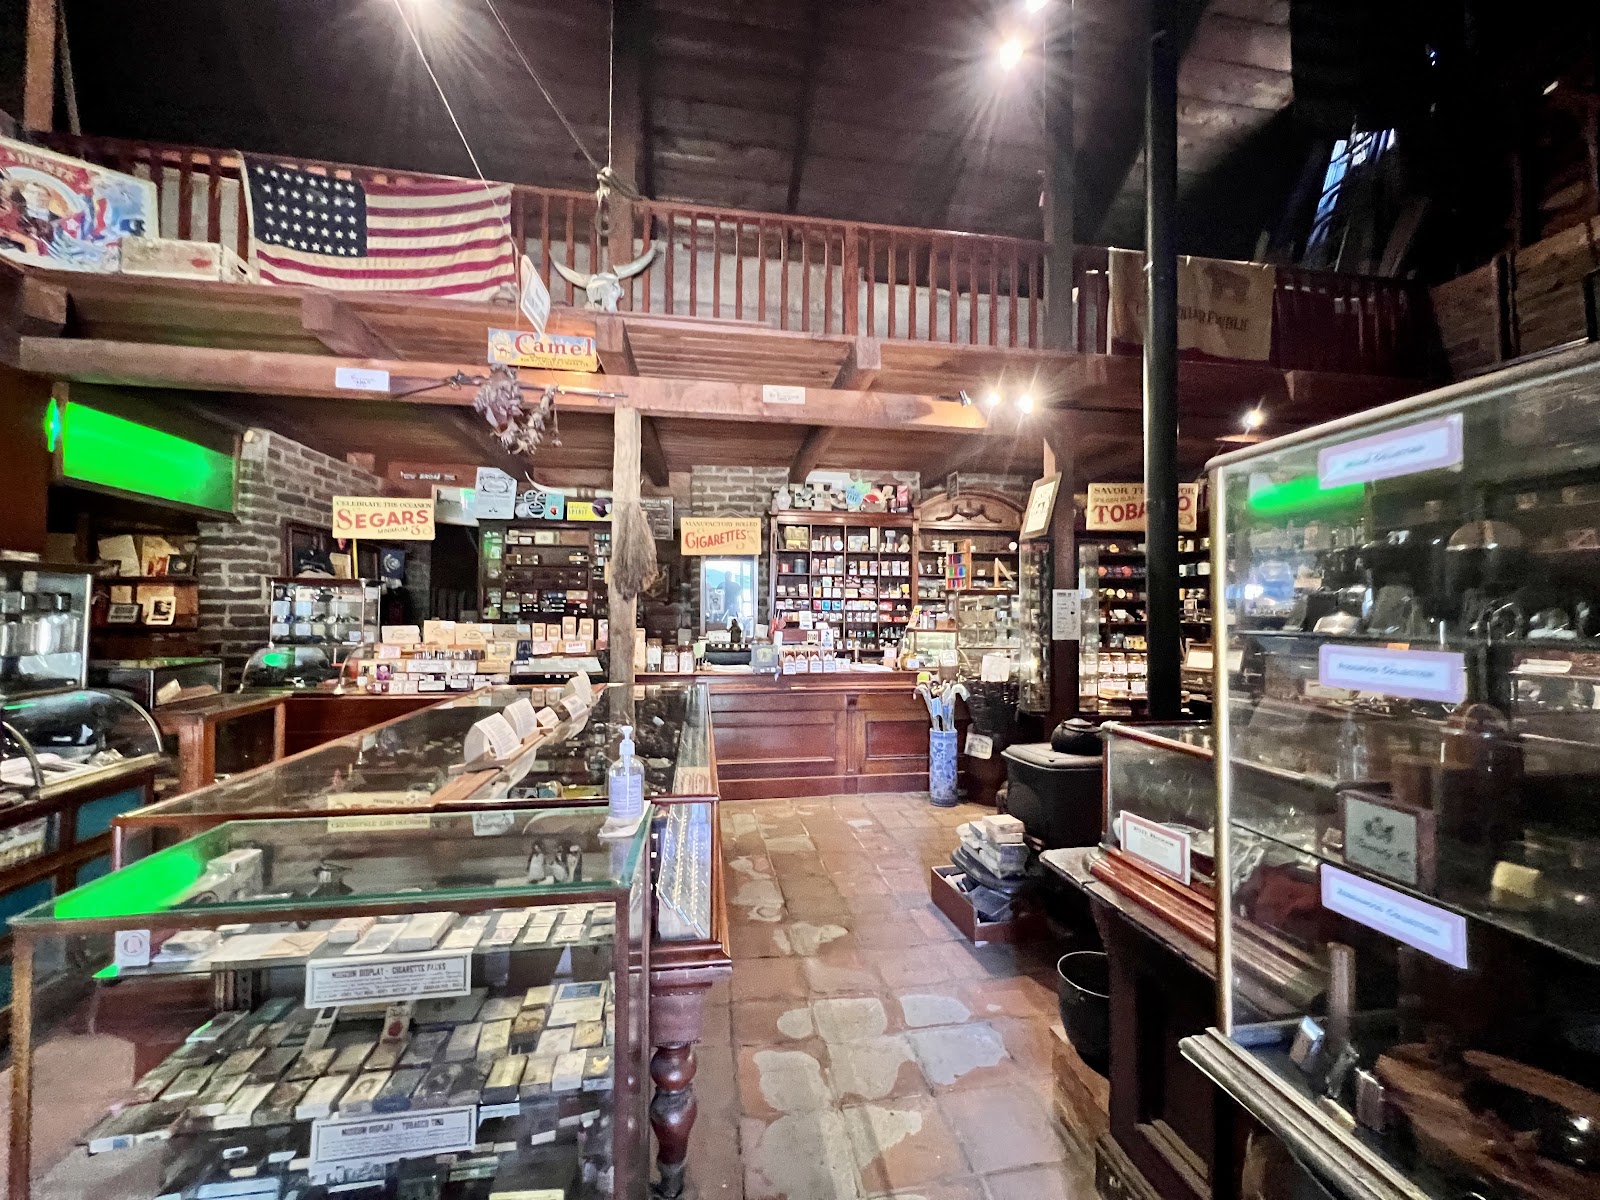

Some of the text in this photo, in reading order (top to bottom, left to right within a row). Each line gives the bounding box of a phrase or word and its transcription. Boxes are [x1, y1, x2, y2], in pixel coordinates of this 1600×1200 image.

[514, 333, 593, 357] Camel
[1094, 487, 1127, 495] SAVOR
[336, 508, 429, 531] SEGARS
[1091, 496, 1191, 525] TOBAO
[377, 526, 408, 534] MINIMUM
